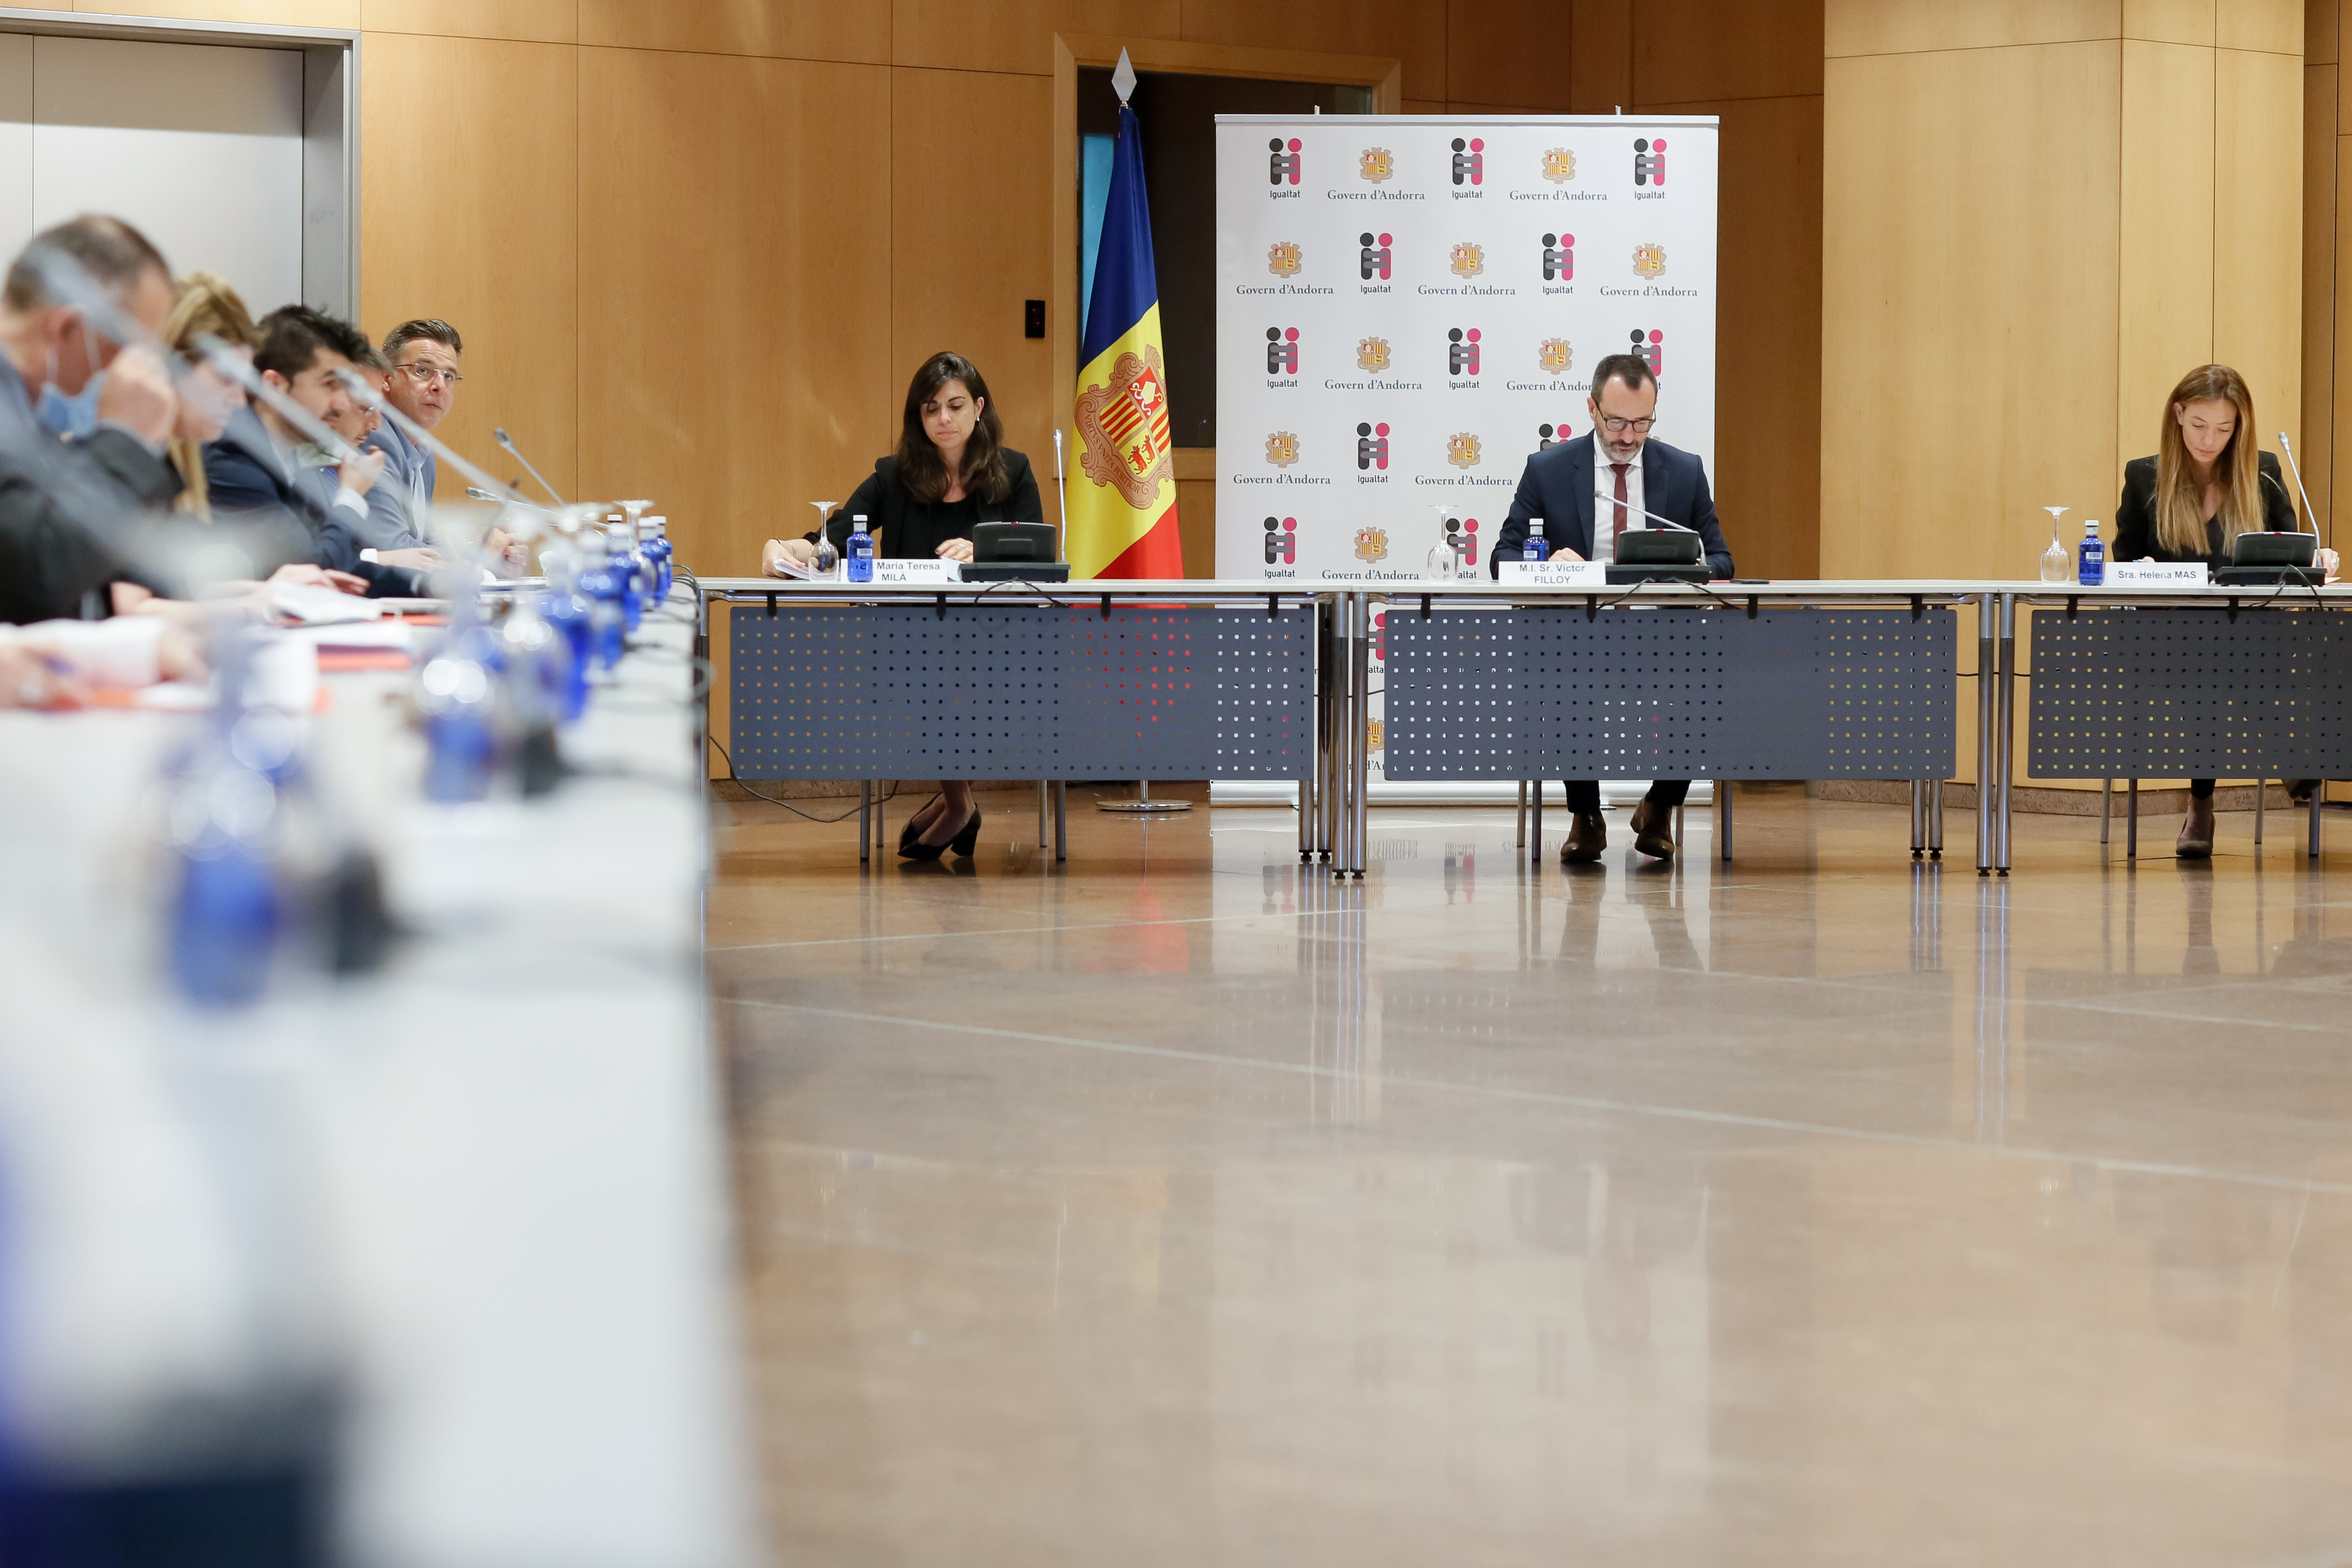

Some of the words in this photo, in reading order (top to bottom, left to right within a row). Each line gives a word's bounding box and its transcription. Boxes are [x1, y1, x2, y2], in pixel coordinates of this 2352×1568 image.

[1270, 189, 1300, 200] Igualtat
[1327, 189, 1367, 200] Govern
[1370, 189, 1425, 200] d'Andorra
[1452, 190, 1483, 200] Igualtat
[1510, 190, 1549, 200] Govern
[1553, 190, 1607, 200] d'Andorra
[1634, 191, 1665, 201] Igualtat
[1236, 285, 1276, 295] Govern
[1279, 284, 1334, 294] d'Andorra
[1361, 285, 1391, 295] Igualtat
[1418, 285, 1457, 295] Govern
[1461, 285, 1516, 295] d'Andorra
[1543, 285, 1573, 295] Igualtat
[1600, 286, 1639, 295] Govern
[1643, 286, 1697, 296] d'Andorra
[1267, 379, 1298, 389] Igualtat
[1324, 379, 1364, 389] Govern
[1367, 379, 1422, 390] d'Andorra
[1449, 380, 1480, 390] Igualtat
[1506, 381, 1546, 391] Govern
[1549, 381, 1592, 391] d'Andor
[1097, 444, 1114, 469] VNITA
[1113, 466, 1140, 493] FORTIOR
[1233, 474, 1273, 484] Govern
[1276, 474, 1331, 485] d'Andorra
[1358, 474, 1388, 485] Igualtat
[1415, 475, 1454, 485] Govern
[1458, 475, 1513, 485] d'Andorra
[882, 572, 906, 581] MILÀ
[1265, 569, 1295, 579] Igualtat
[1322, 570, 1361, 579] Govern
[1365, 569, 1419, 580] d'Andorra
[1458, 570, 1477, 579] altat
[1534, 575, 1571, 584] FILLOY
